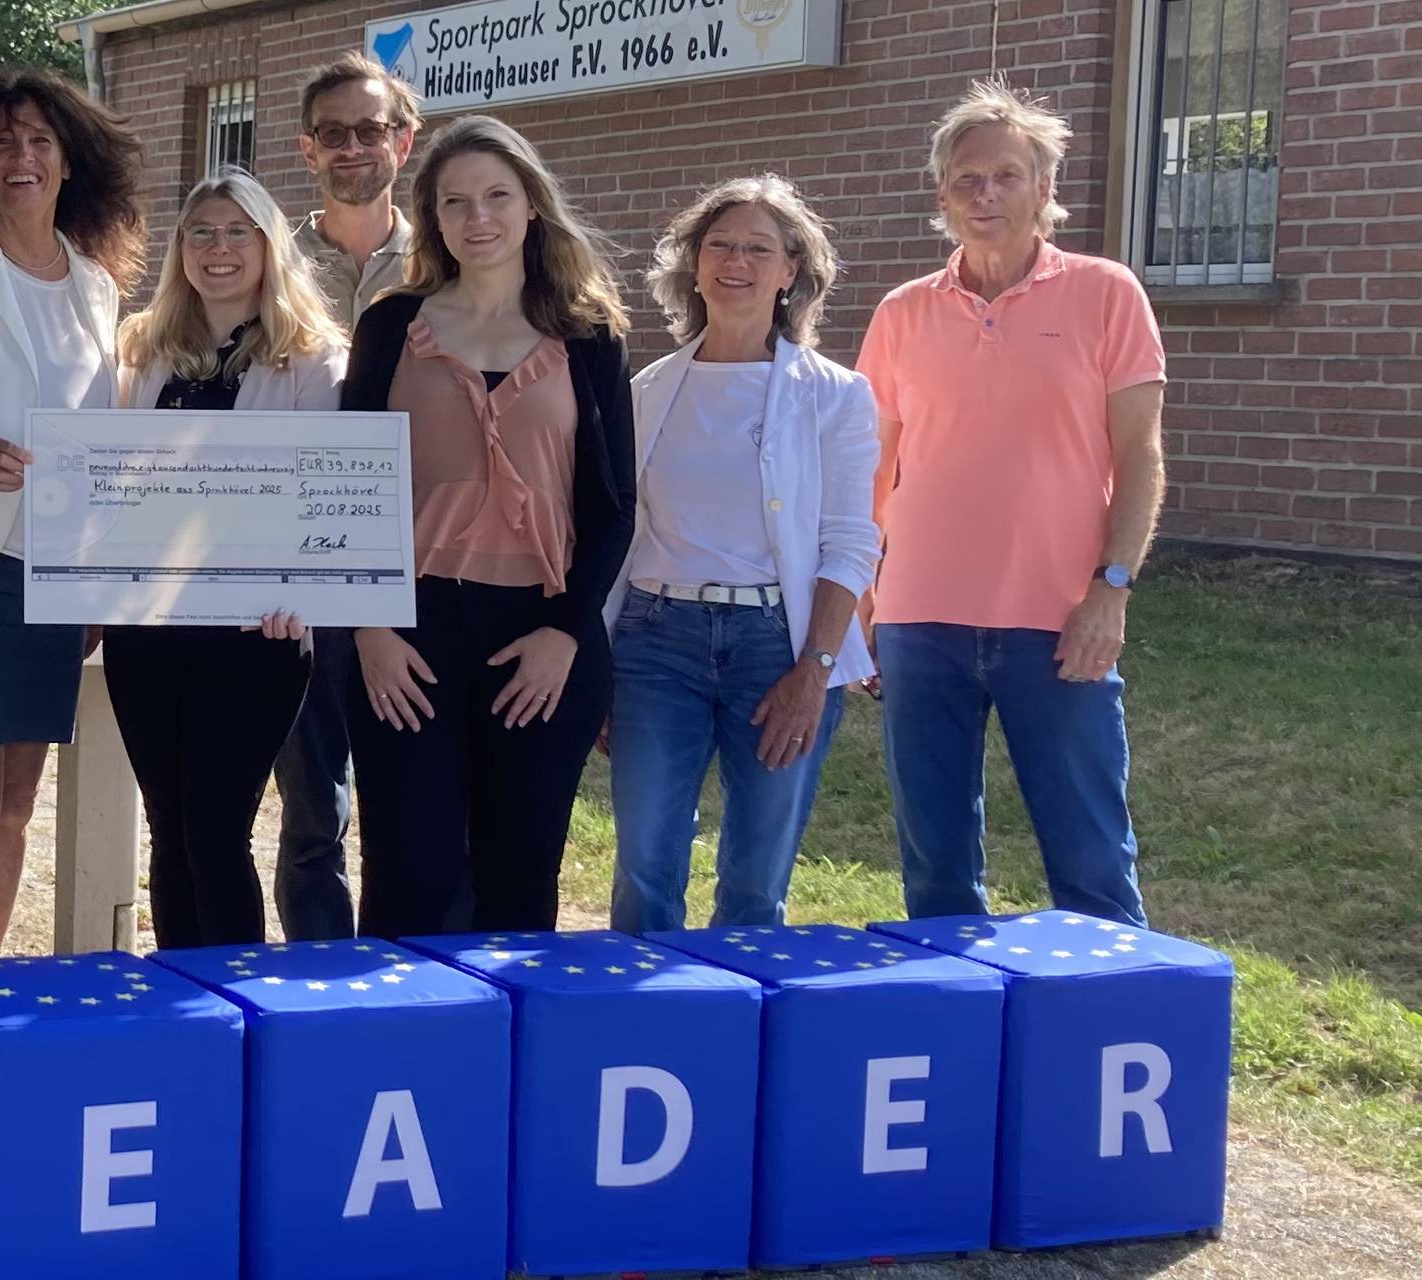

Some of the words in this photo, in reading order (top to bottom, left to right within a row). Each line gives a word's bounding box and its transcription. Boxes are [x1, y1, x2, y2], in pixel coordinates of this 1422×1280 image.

[426, 0, 546, 61] Sportpark
[556, 0, 724, 40] Sprock
[424, 55, 560, 100] Hiddinghauser
[571, 38, 607, 78] F.V.
[620, 32, 675, 71] 1966
[687, 20, 729, 60] e.V.
[298, 458, 324, 472] EUR
[94, 479, 171, 498] Kleinprojekte
[176, 486, 193, 494] aus
[259, 483, 283, 495] 2025
[298, 480, 380, 499] Sprockhövel
